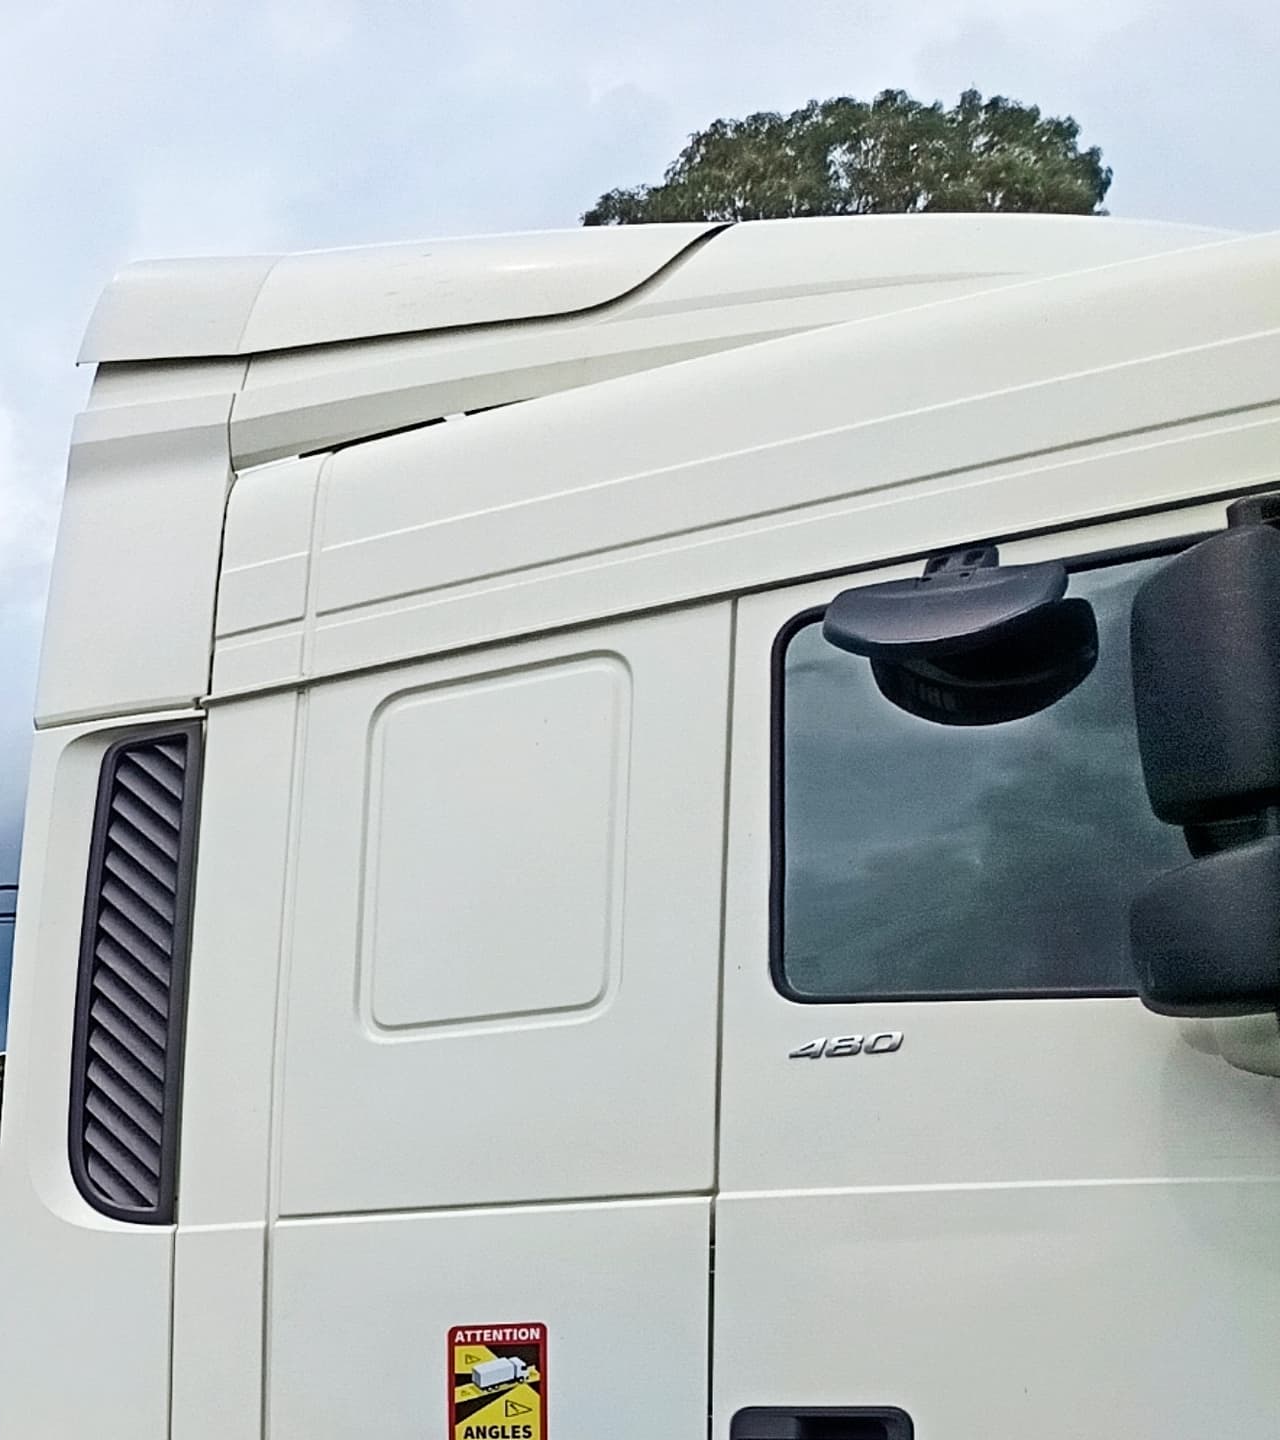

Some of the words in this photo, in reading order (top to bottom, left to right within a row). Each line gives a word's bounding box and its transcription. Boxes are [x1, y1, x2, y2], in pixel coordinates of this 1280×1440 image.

[789, 1031, 904, 1060] 480
[454, 1328, 540, 1343] ATTENTION
[463, 1425, 532, 1440] ANGLES
